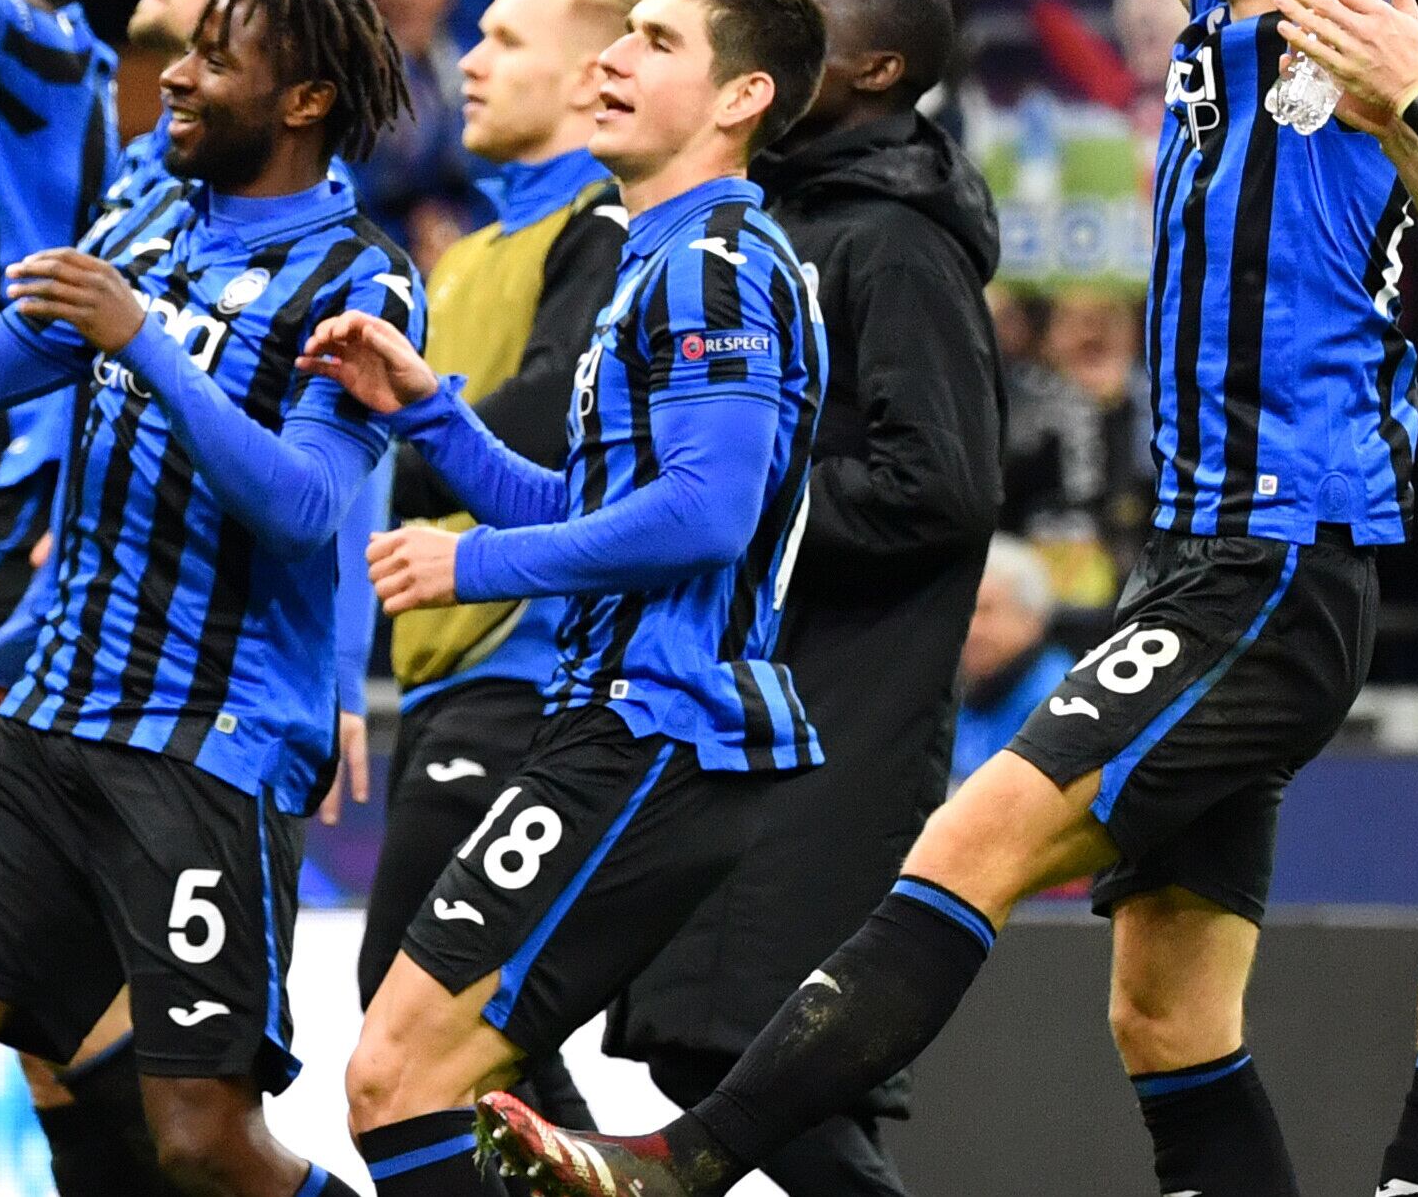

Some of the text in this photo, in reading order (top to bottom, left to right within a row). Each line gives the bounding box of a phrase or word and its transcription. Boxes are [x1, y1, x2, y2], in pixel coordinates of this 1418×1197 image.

[704, 334, 771, 356] RESPECT
[456, 785, 563, 890] 18
[167, 868, 227, 964] 5
